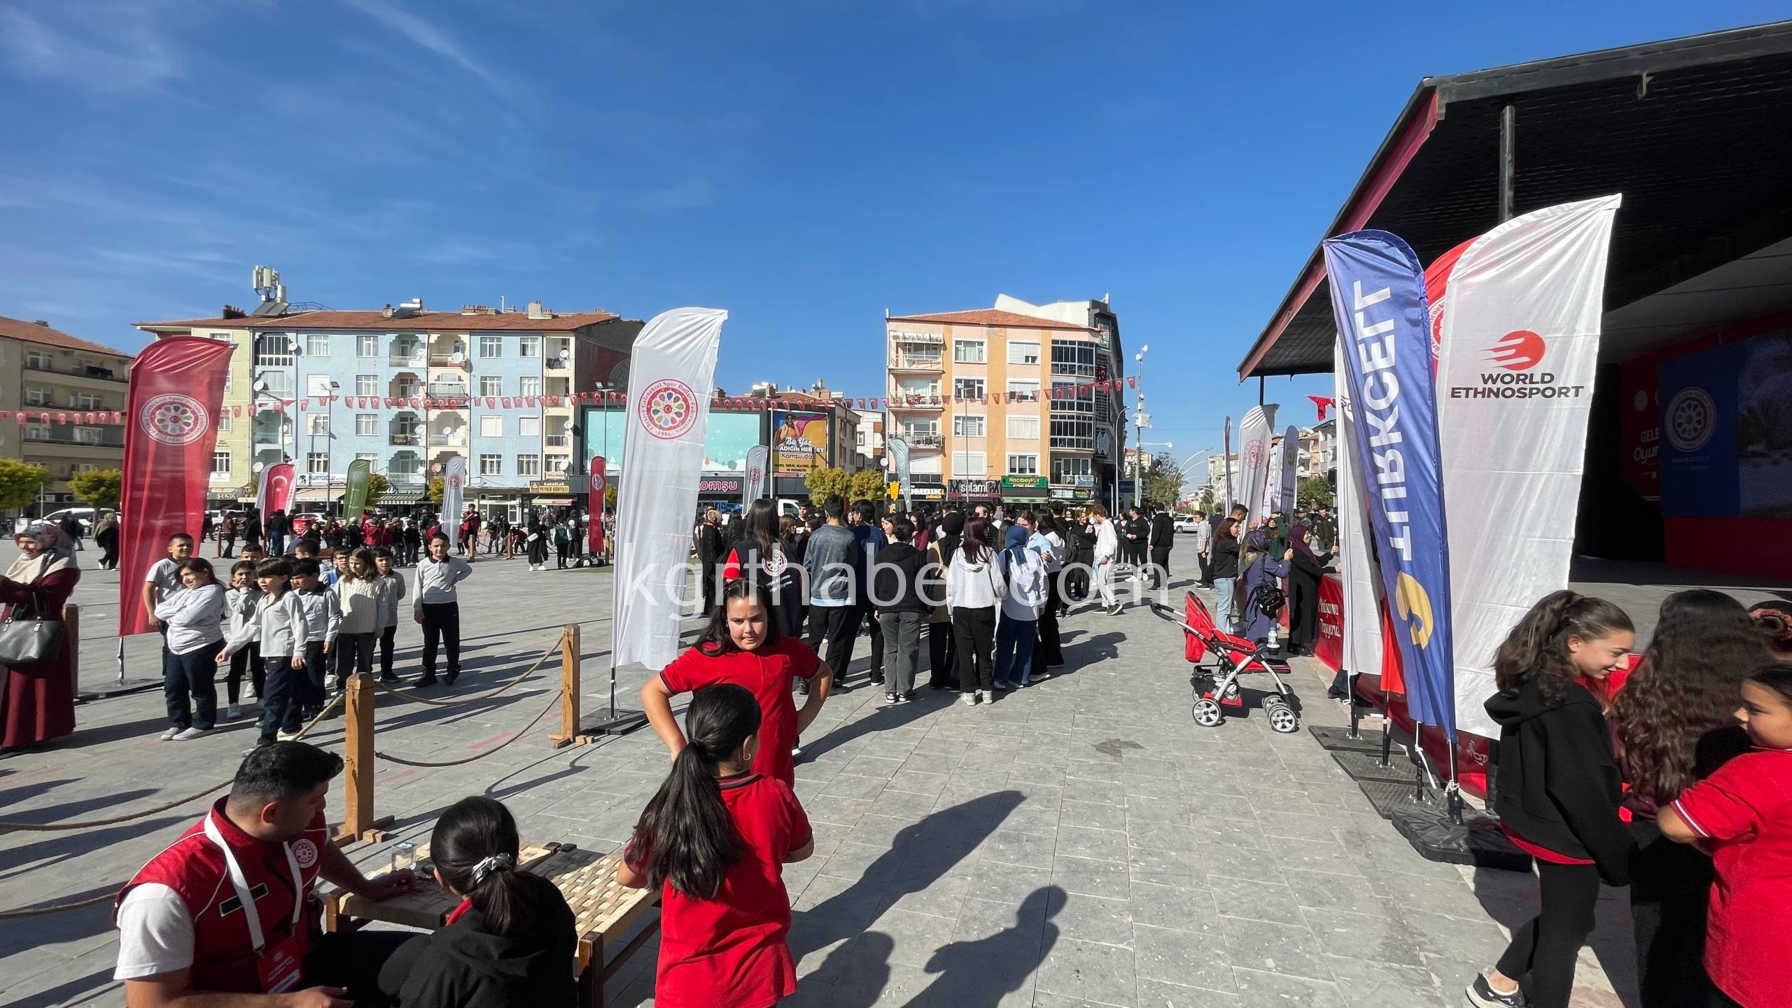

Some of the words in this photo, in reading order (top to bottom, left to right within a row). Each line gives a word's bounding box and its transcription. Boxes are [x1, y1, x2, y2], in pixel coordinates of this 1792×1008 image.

[1480, 373, 1555, 385] WORLD
[1450, 385, 1585, 399] ETHNOSPORT
[700, 481, 738, 493] omşu
